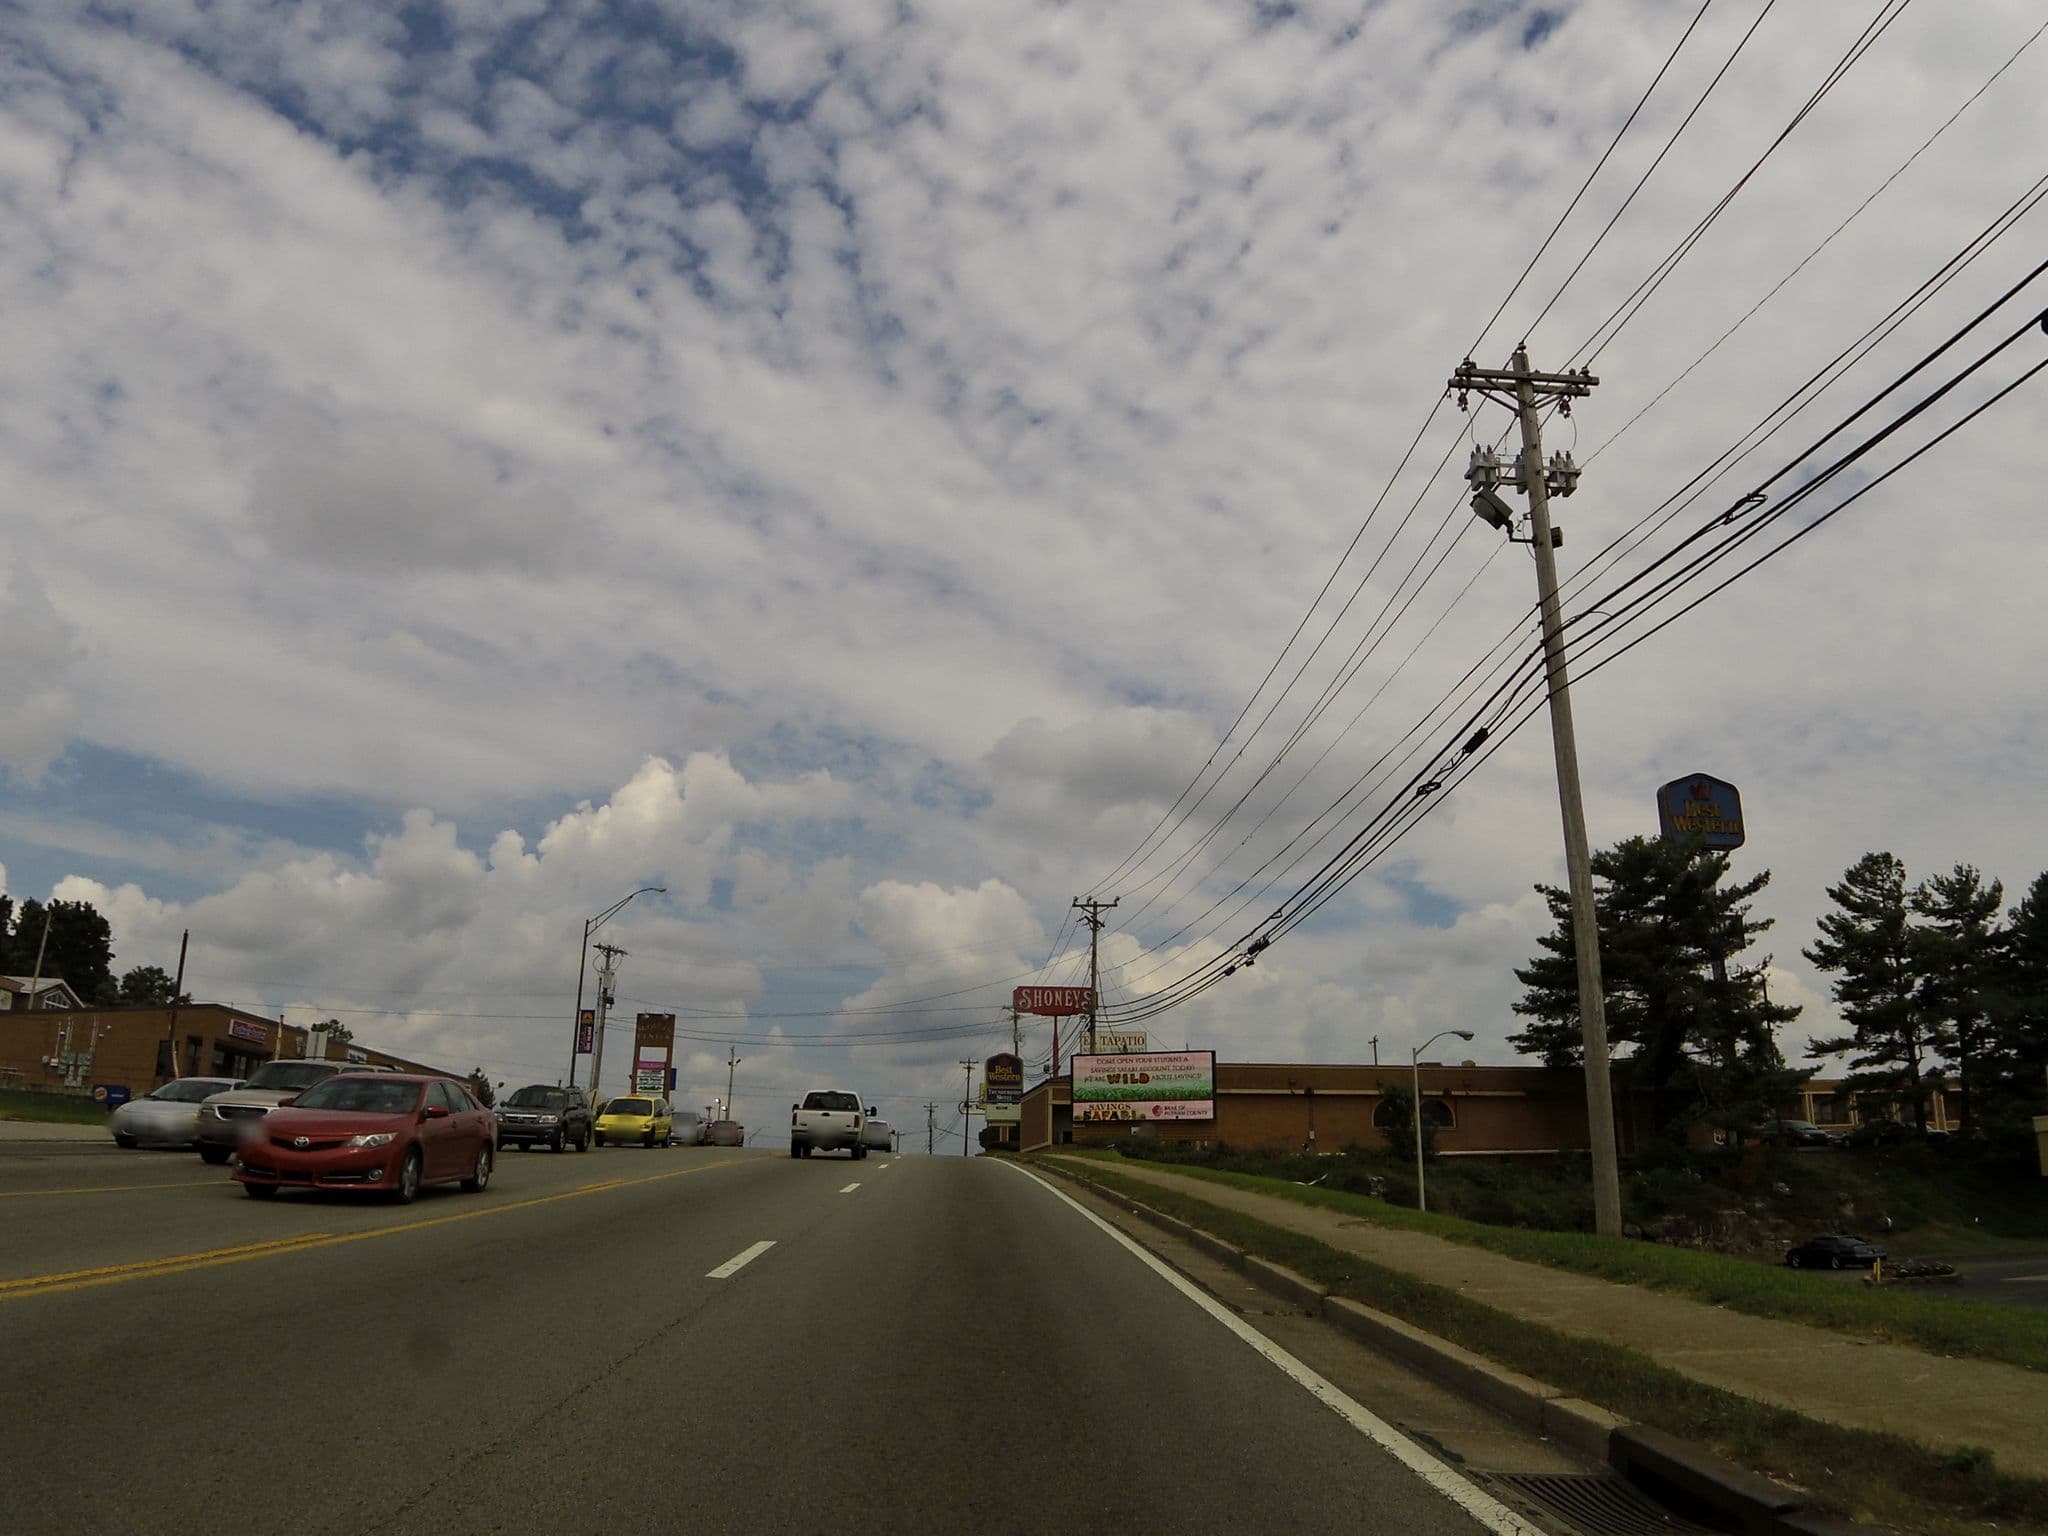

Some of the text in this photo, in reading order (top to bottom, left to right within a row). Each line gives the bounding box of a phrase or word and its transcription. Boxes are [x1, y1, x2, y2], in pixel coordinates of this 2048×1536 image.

[1100, 1035, 1145, 1046] TAPATIO
[1106, 1073, 1150, 1085] WILD
[1088, 1103, 1131, 1111] SAVINGS
